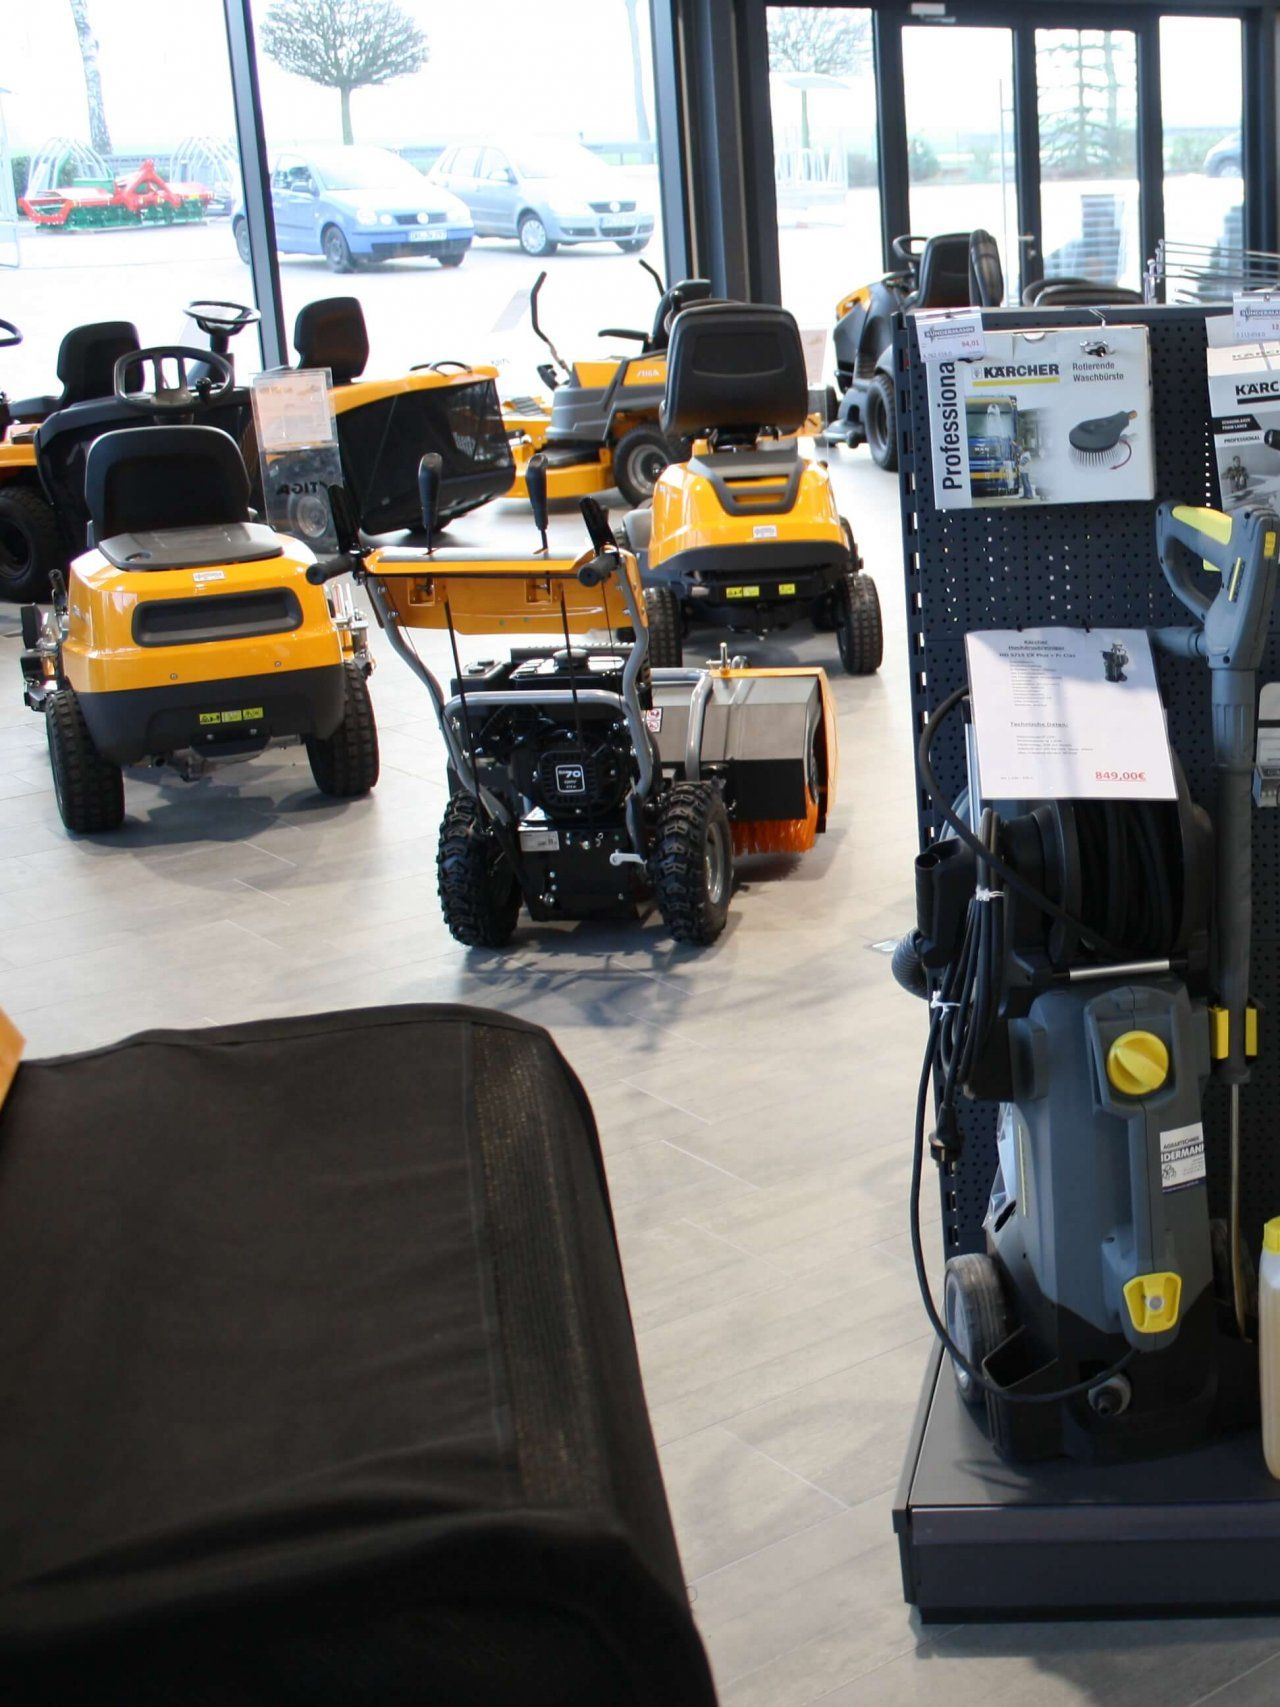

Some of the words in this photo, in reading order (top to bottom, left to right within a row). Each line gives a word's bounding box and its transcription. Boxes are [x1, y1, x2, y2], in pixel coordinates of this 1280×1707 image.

[983, 363, 1060, 379] KÄRCHER
[1072, 361, 1115, 371] Rotierende
[1072, 372, 1125, 382] Waschbürste
[937, 362, 963, 490] Professiona
[1095, 771, 1146, 781] 849,00€
